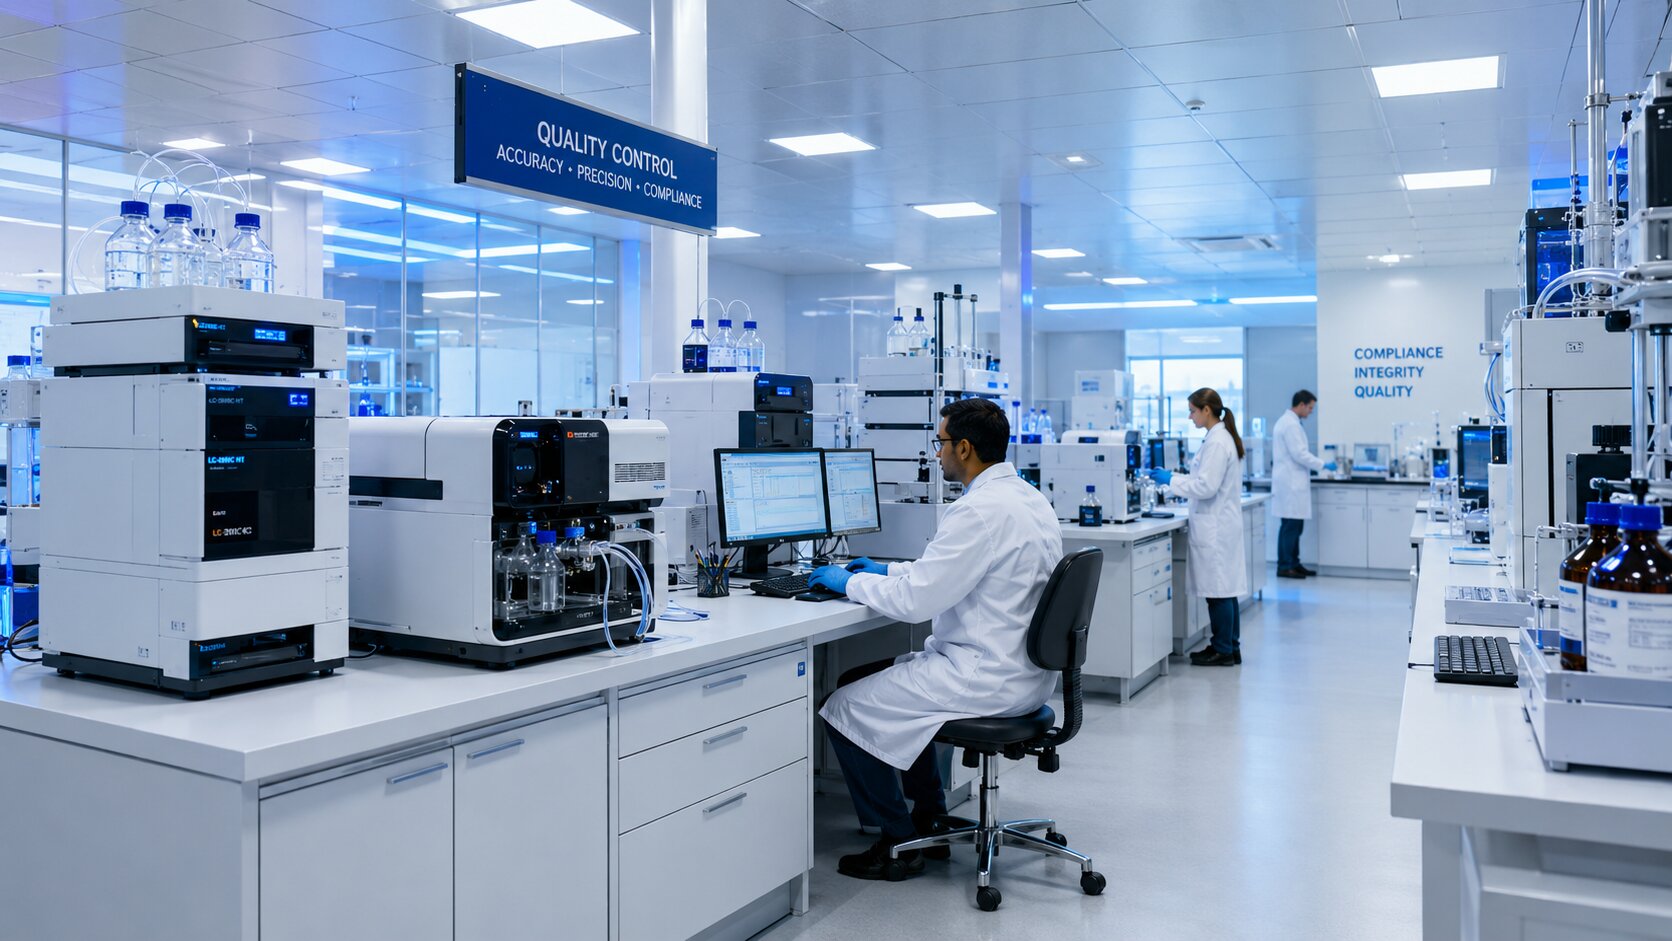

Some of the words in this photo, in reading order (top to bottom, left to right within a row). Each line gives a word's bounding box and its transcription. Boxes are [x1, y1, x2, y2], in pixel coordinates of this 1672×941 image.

[537, 121, 607, 157] QUALITY
[612, 143, 677, 180] CONTROL
[496, 144, 564, 175] ACCURACY
[577, 164, 632, 192] PRECISION
[644, 182, 702, 209] COMPLIANCE
[1354, 347, 1443, 360] COMPLIANCE
[1354, 366, 1424, 378] INTEGRITY
[1354, 385, 1413, 399] QUALITY
